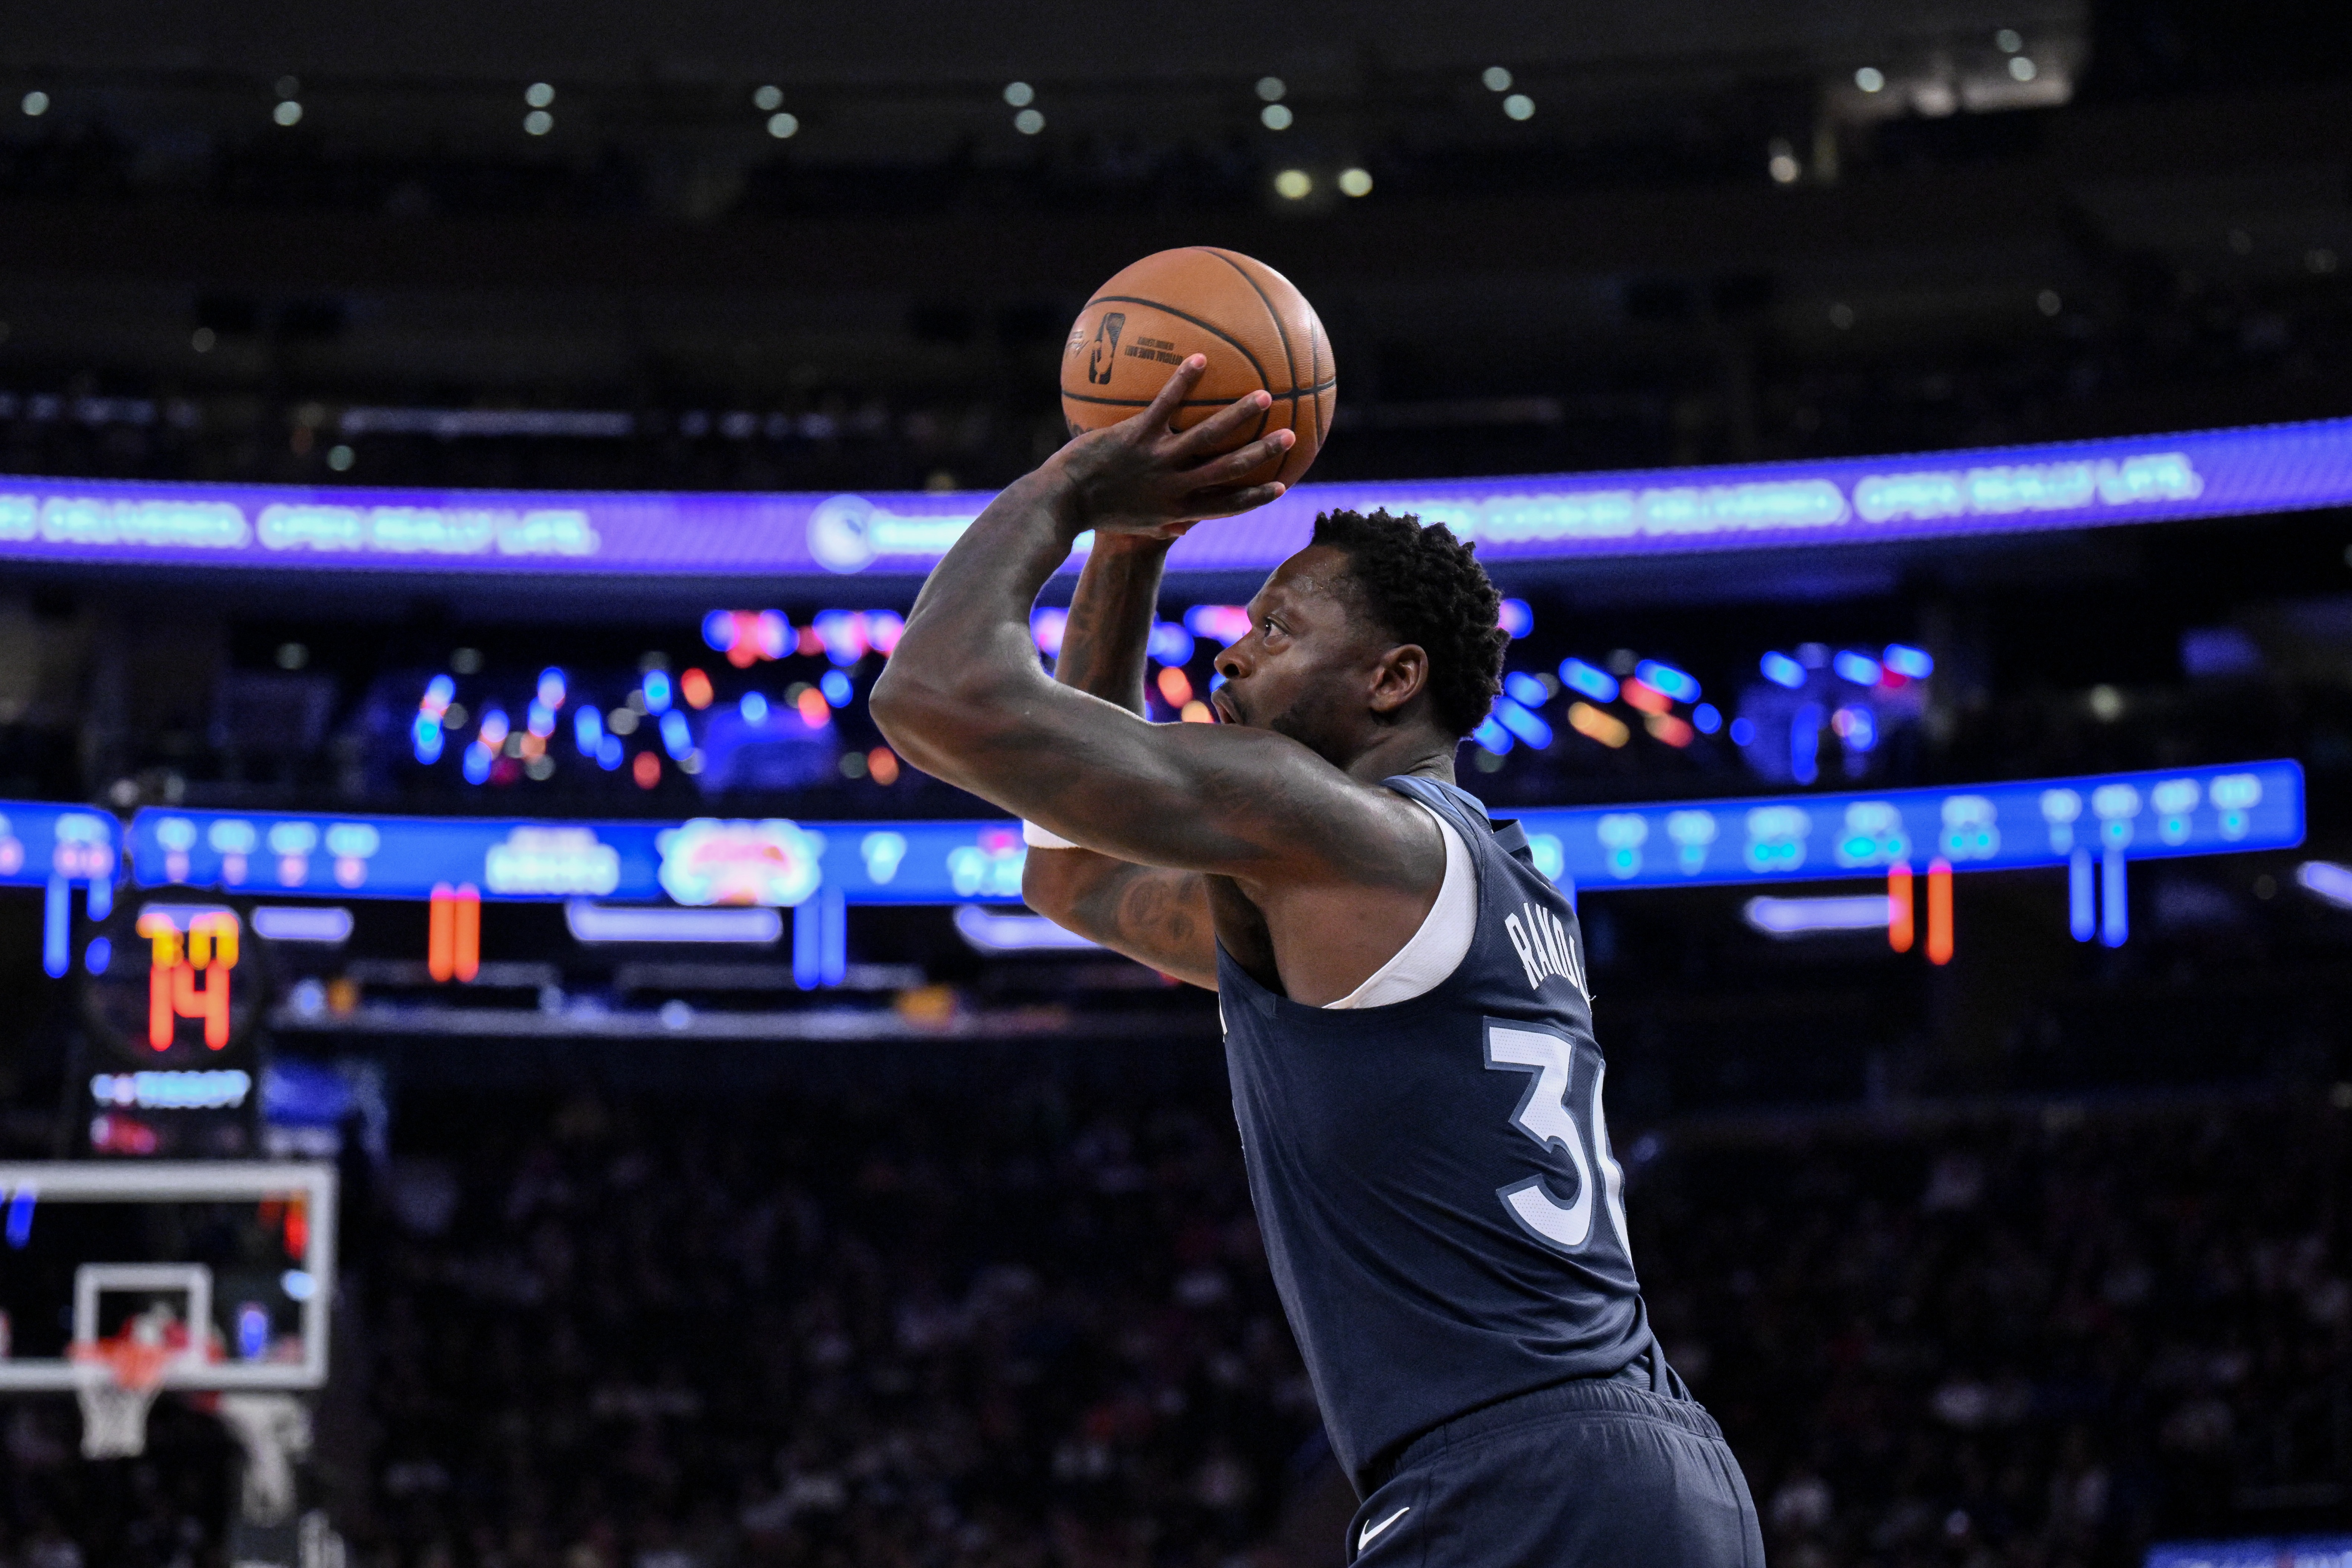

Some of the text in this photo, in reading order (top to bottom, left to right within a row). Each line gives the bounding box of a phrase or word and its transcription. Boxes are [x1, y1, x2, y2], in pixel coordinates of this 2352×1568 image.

[150, 957, 229, 1051] 14
[1505, 902, 1592, 1018] RANDL
[1483, 1016, 1636, 1279] 3
